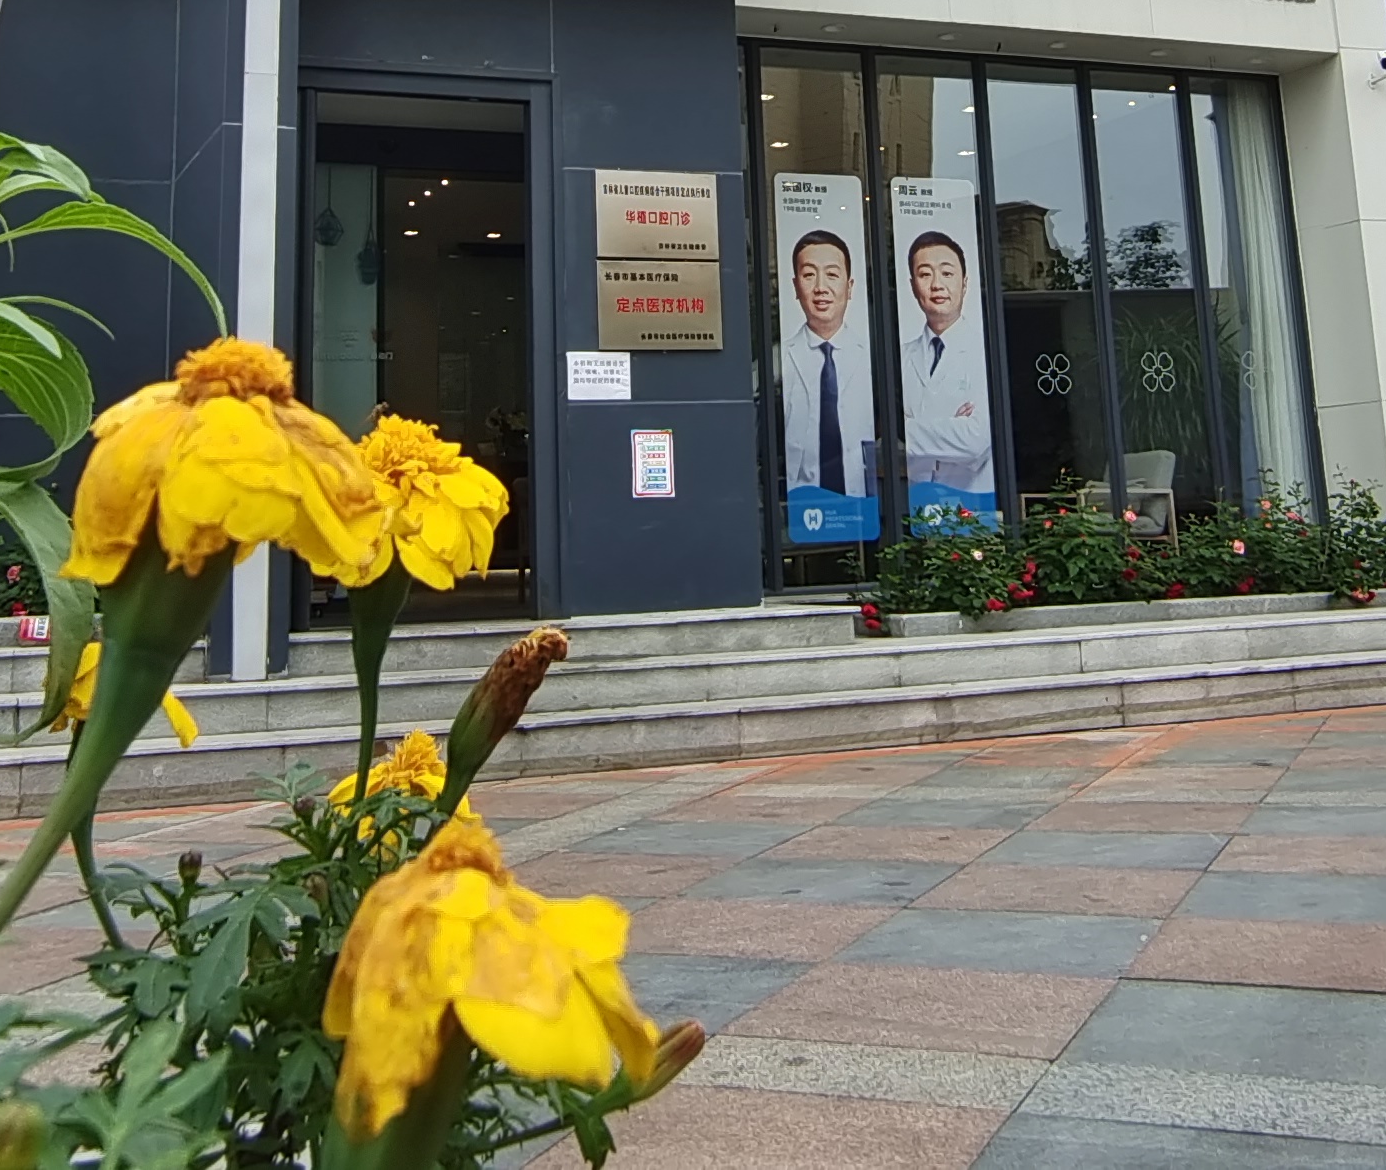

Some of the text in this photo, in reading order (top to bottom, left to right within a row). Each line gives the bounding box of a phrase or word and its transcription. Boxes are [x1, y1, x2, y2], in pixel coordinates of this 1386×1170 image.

[625, 210, 690, 226] 华植口腔门诊
[604, 271, 679, 283] 长春市基本医疗保险
[616, 297, 704, 314] 定点医疗机构
